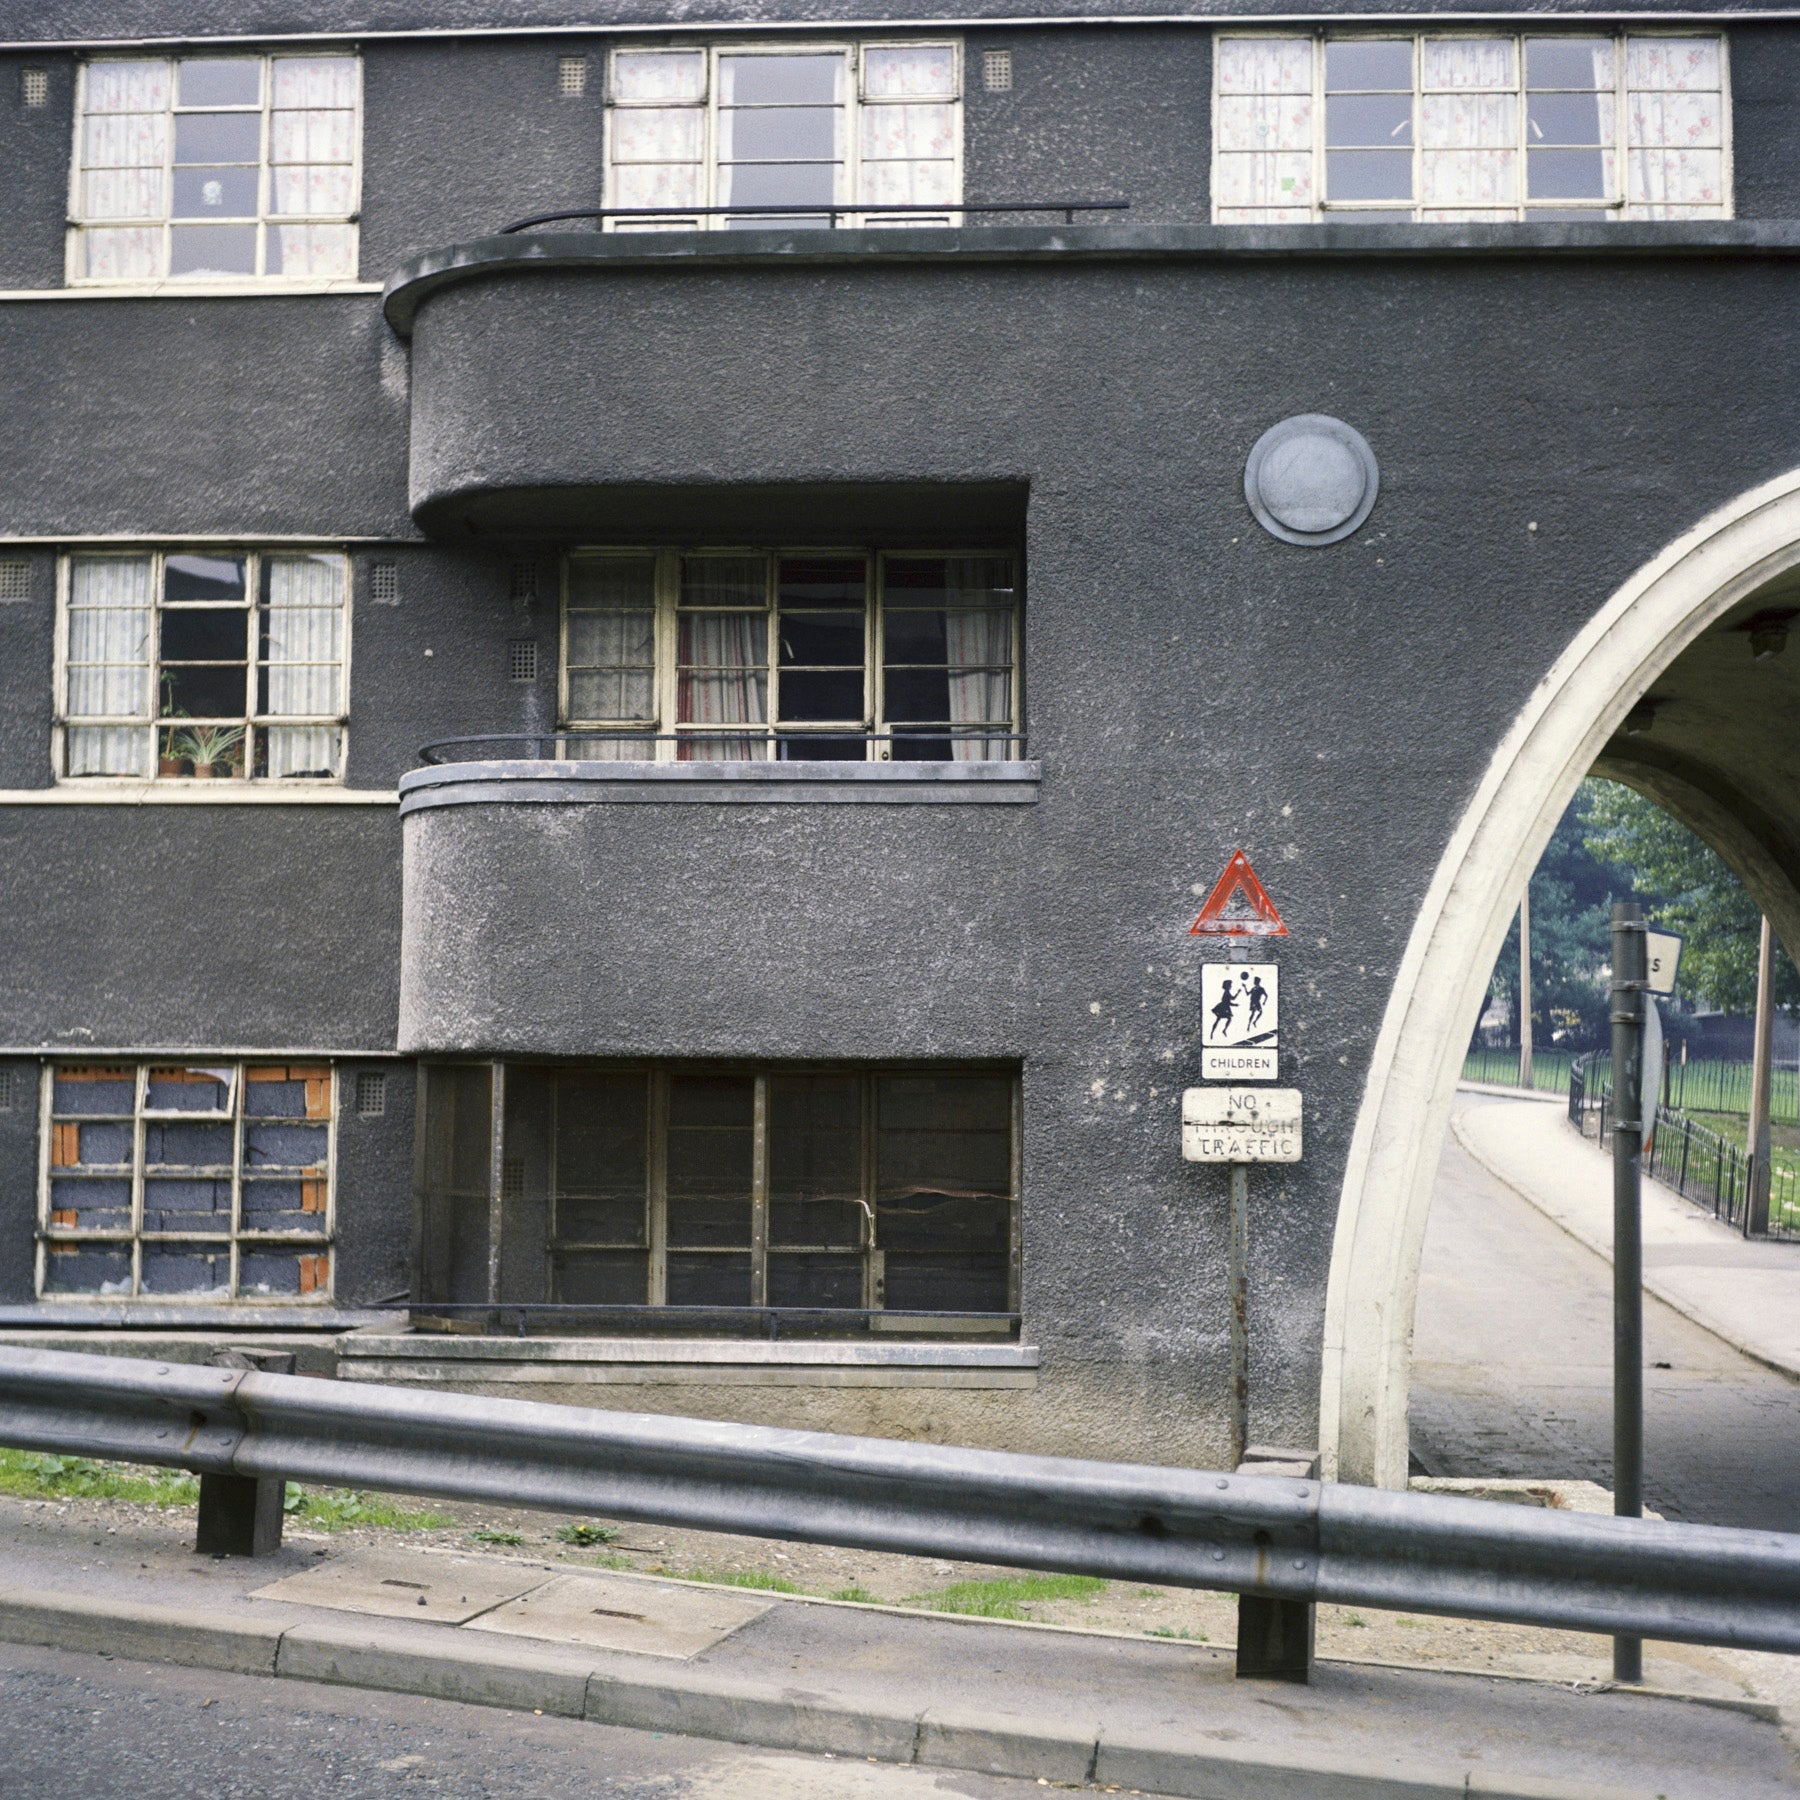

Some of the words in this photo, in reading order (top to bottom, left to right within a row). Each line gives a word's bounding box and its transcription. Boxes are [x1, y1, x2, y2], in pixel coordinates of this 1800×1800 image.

[1210, 1058, 1270, 1068] CHILDREN
[1228, 1094, 1257, 1110] NO
[1200, 1139, 1293, 1155] TRAFFIC
